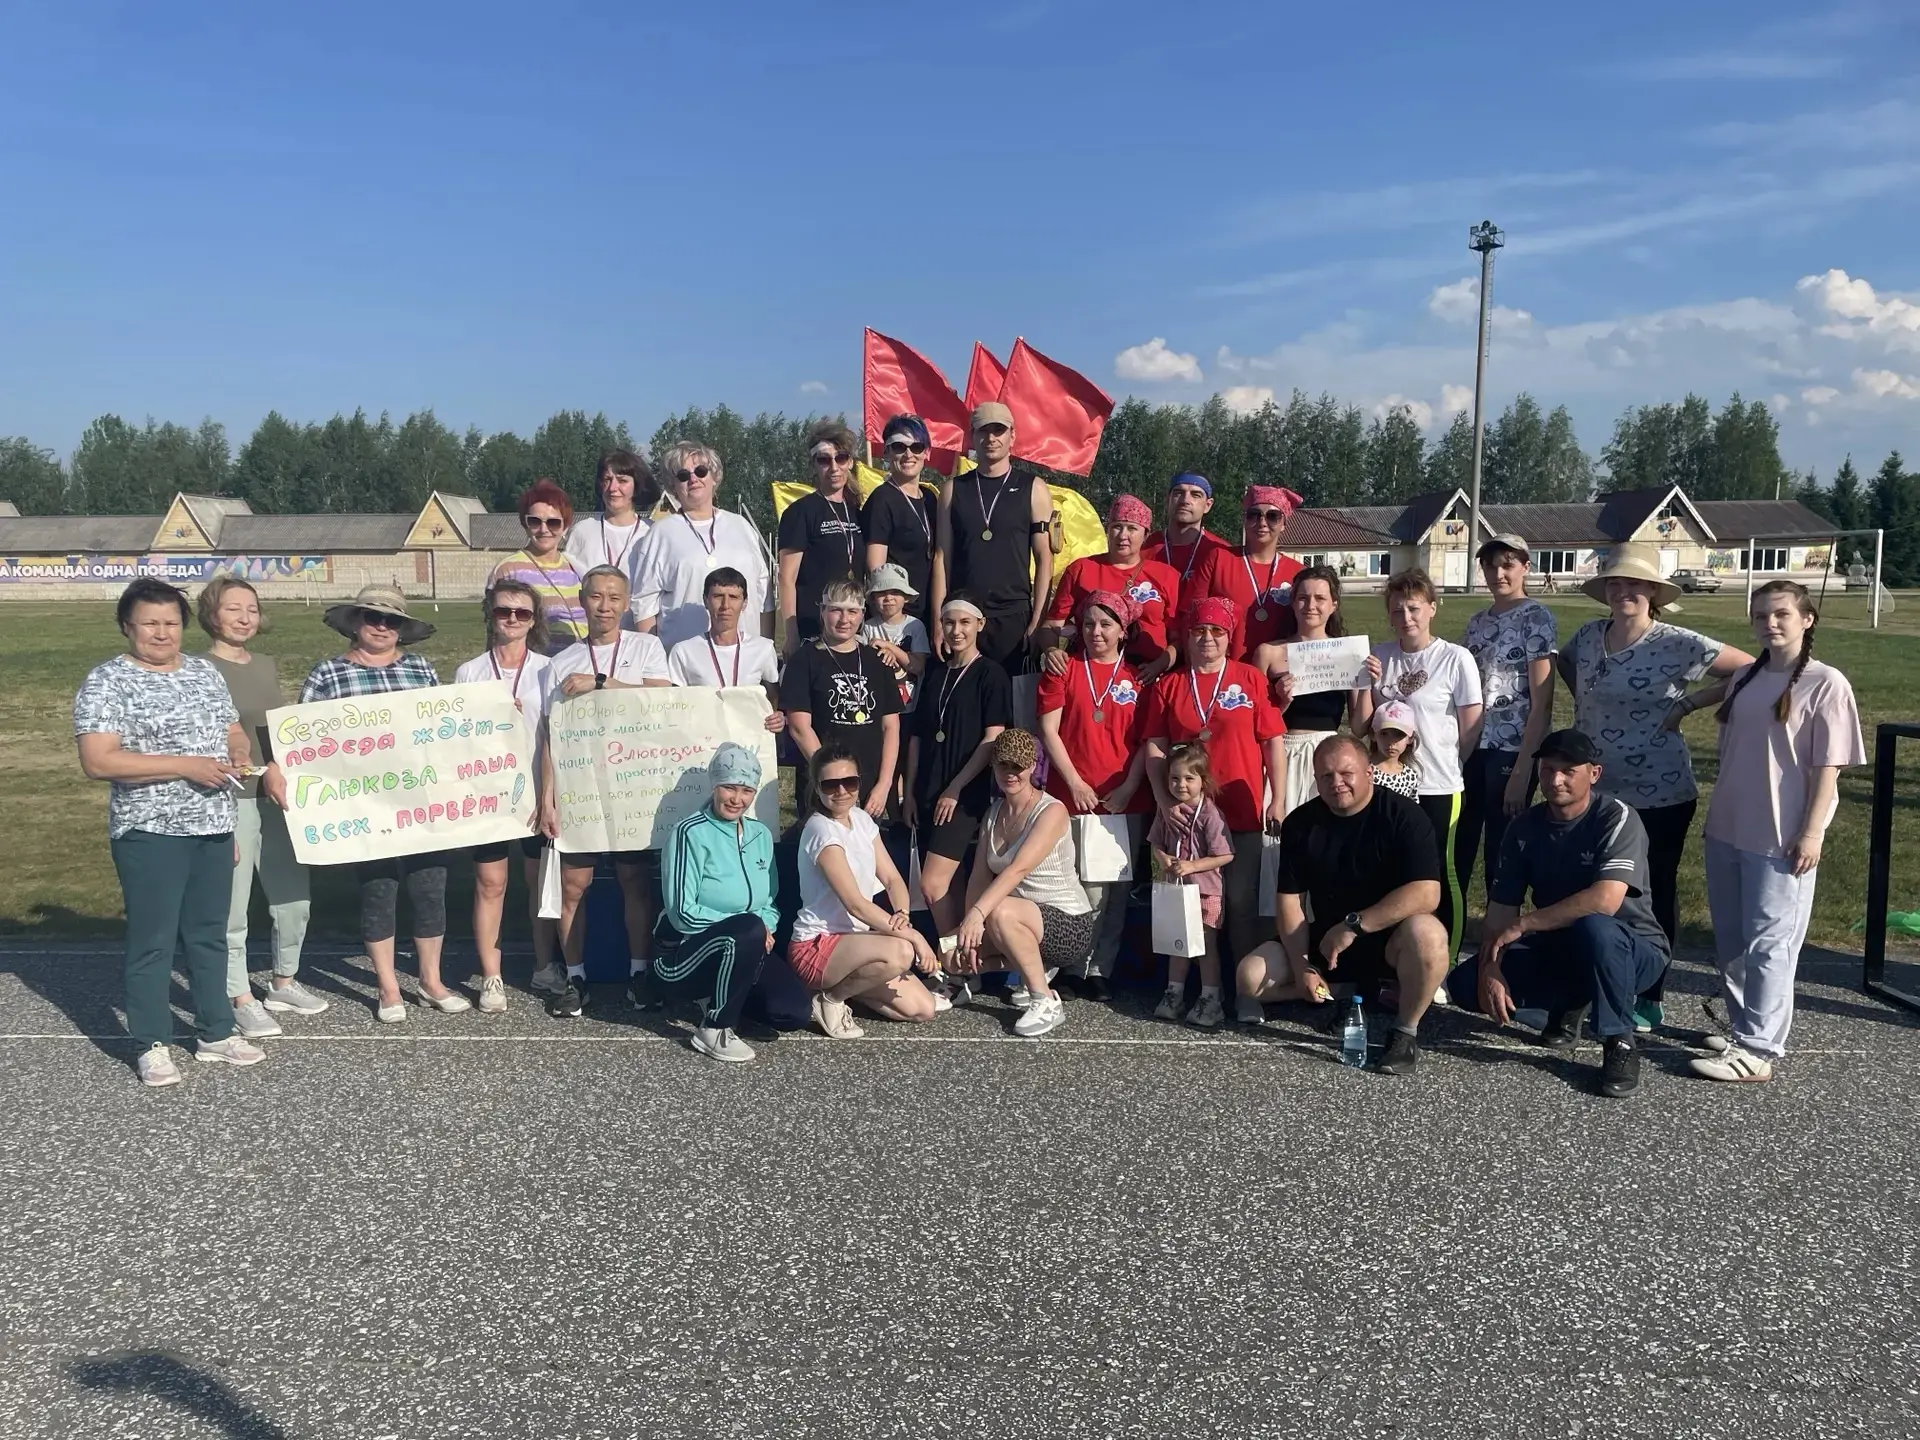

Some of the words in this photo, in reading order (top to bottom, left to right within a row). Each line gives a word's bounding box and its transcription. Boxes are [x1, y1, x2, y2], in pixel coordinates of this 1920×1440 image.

[12, 564, 89, 579] КОМАНДА!
[92, 564, 136, 579] ОДНА
[137, 564, 203, 578] ПОБЕДА!
[553, 699, 627, 728] Модные
[277, 704, 392, 745] Сегодня
[559, 725, 606, 748] крутые
[558, 756, 595, 771] наши
[616, 827, 638, 839] не
